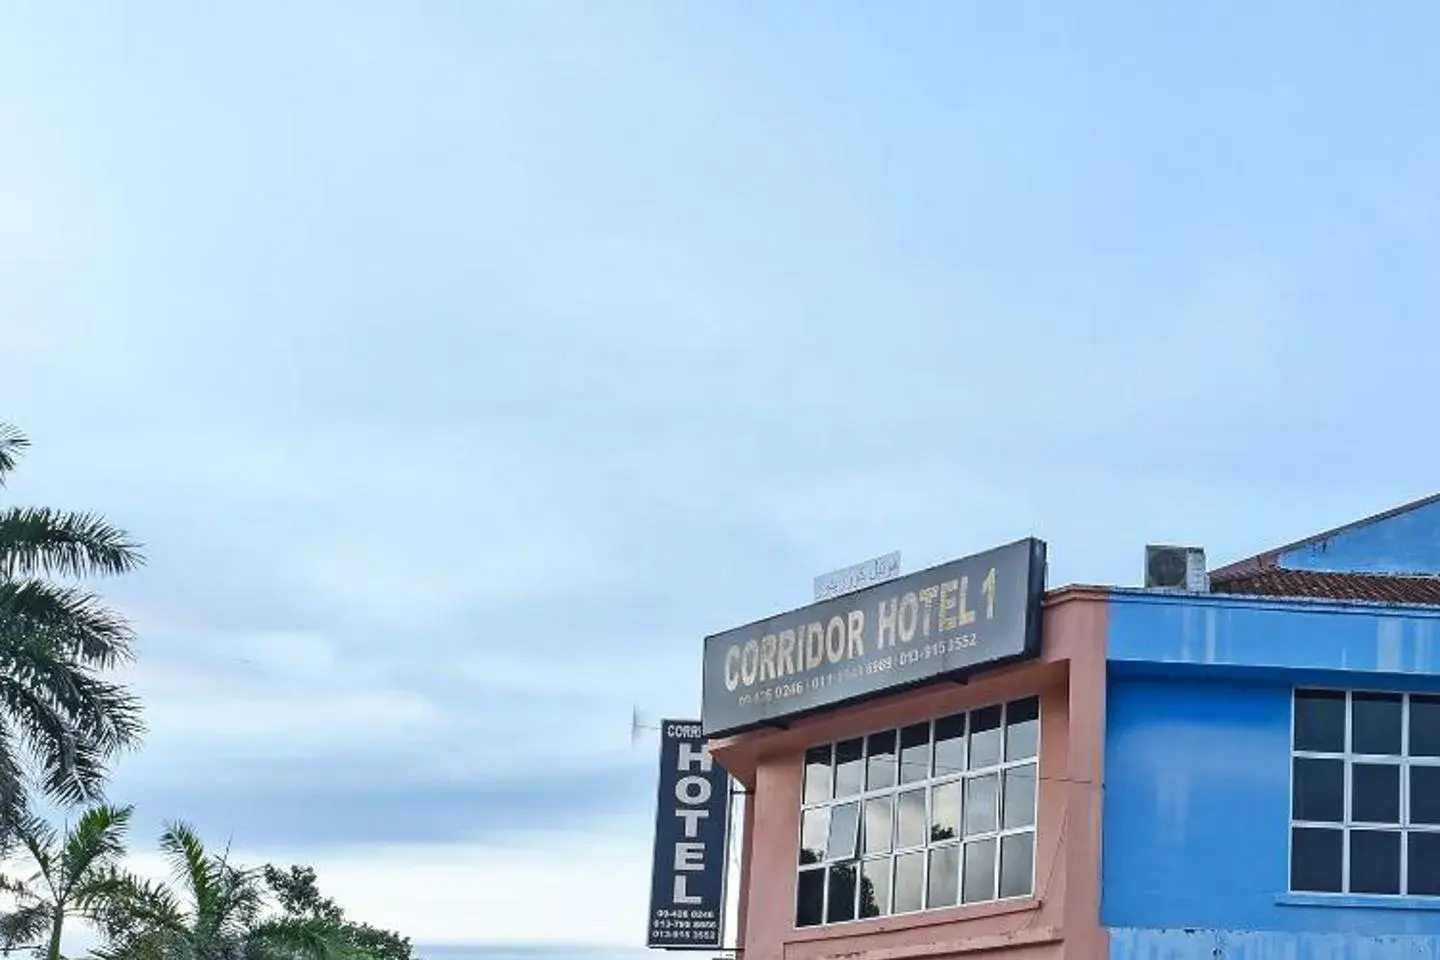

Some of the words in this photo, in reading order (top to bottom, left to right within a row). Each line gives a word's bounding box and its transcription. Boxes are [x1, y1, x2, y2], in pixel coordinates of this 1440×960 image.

[724, 611, 865, 692] CORRIDOR
[877, 575, 976, 650] HOTEL
[981, 567, 997, 620] 1
[673, 742, 713, 905] HOTEL
